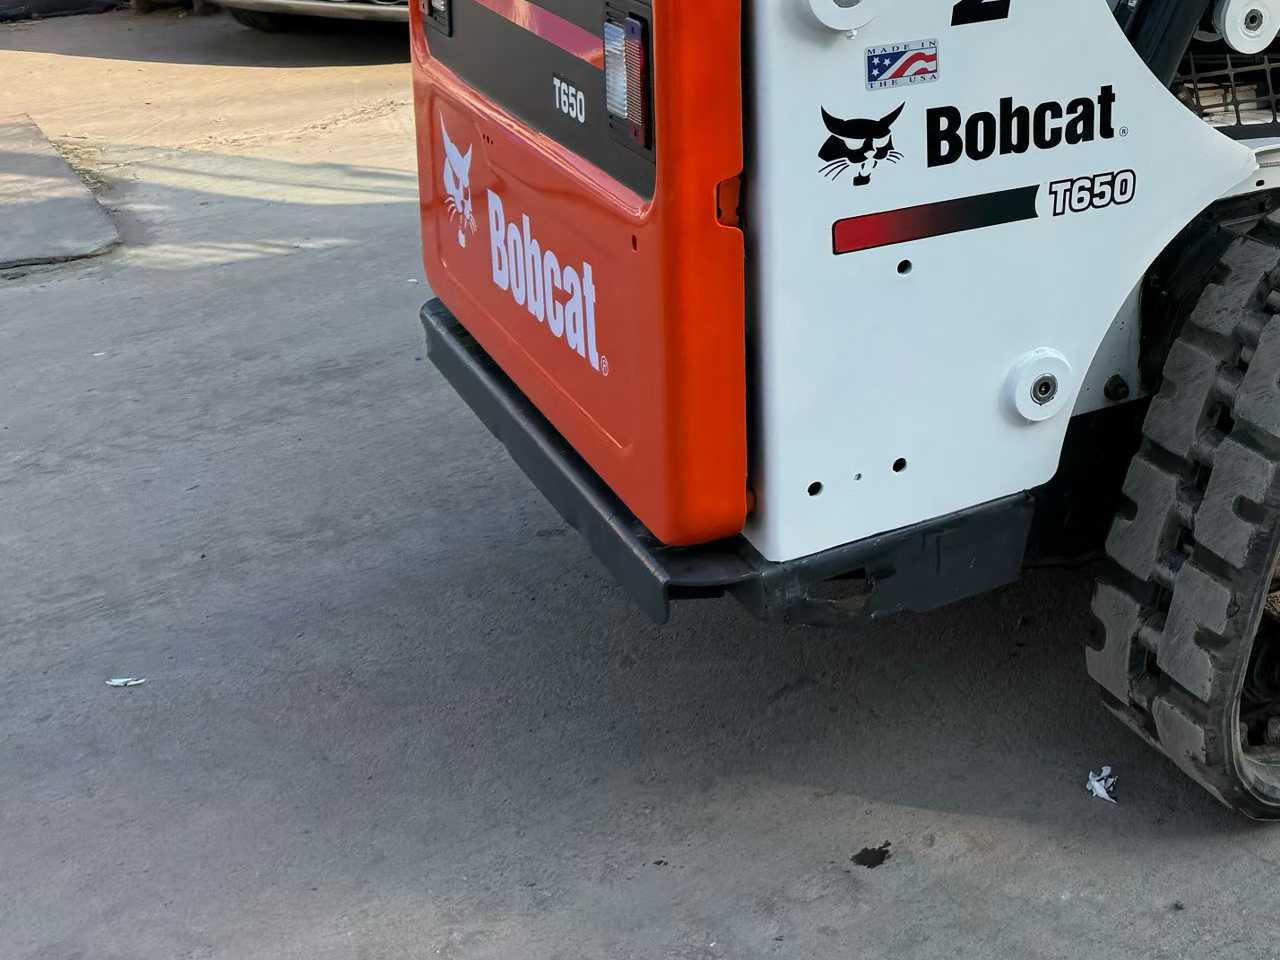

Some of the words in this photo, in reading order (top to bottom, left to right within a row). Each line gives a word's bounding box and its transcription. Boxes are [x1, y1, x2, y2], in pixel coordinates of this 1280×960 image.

[867, 44, 910, 56] MADE
[921, 40, 937, 48] IN
[553, 76, 585, 123] T650
[869, 79, 898, 89] THE
[909, 73, 937, 83] USA
[926, 85, 1115, 168] Bobcat
[1049, 169, 1136, 217] T650
[487, 188, 600, 371] Bobcat
